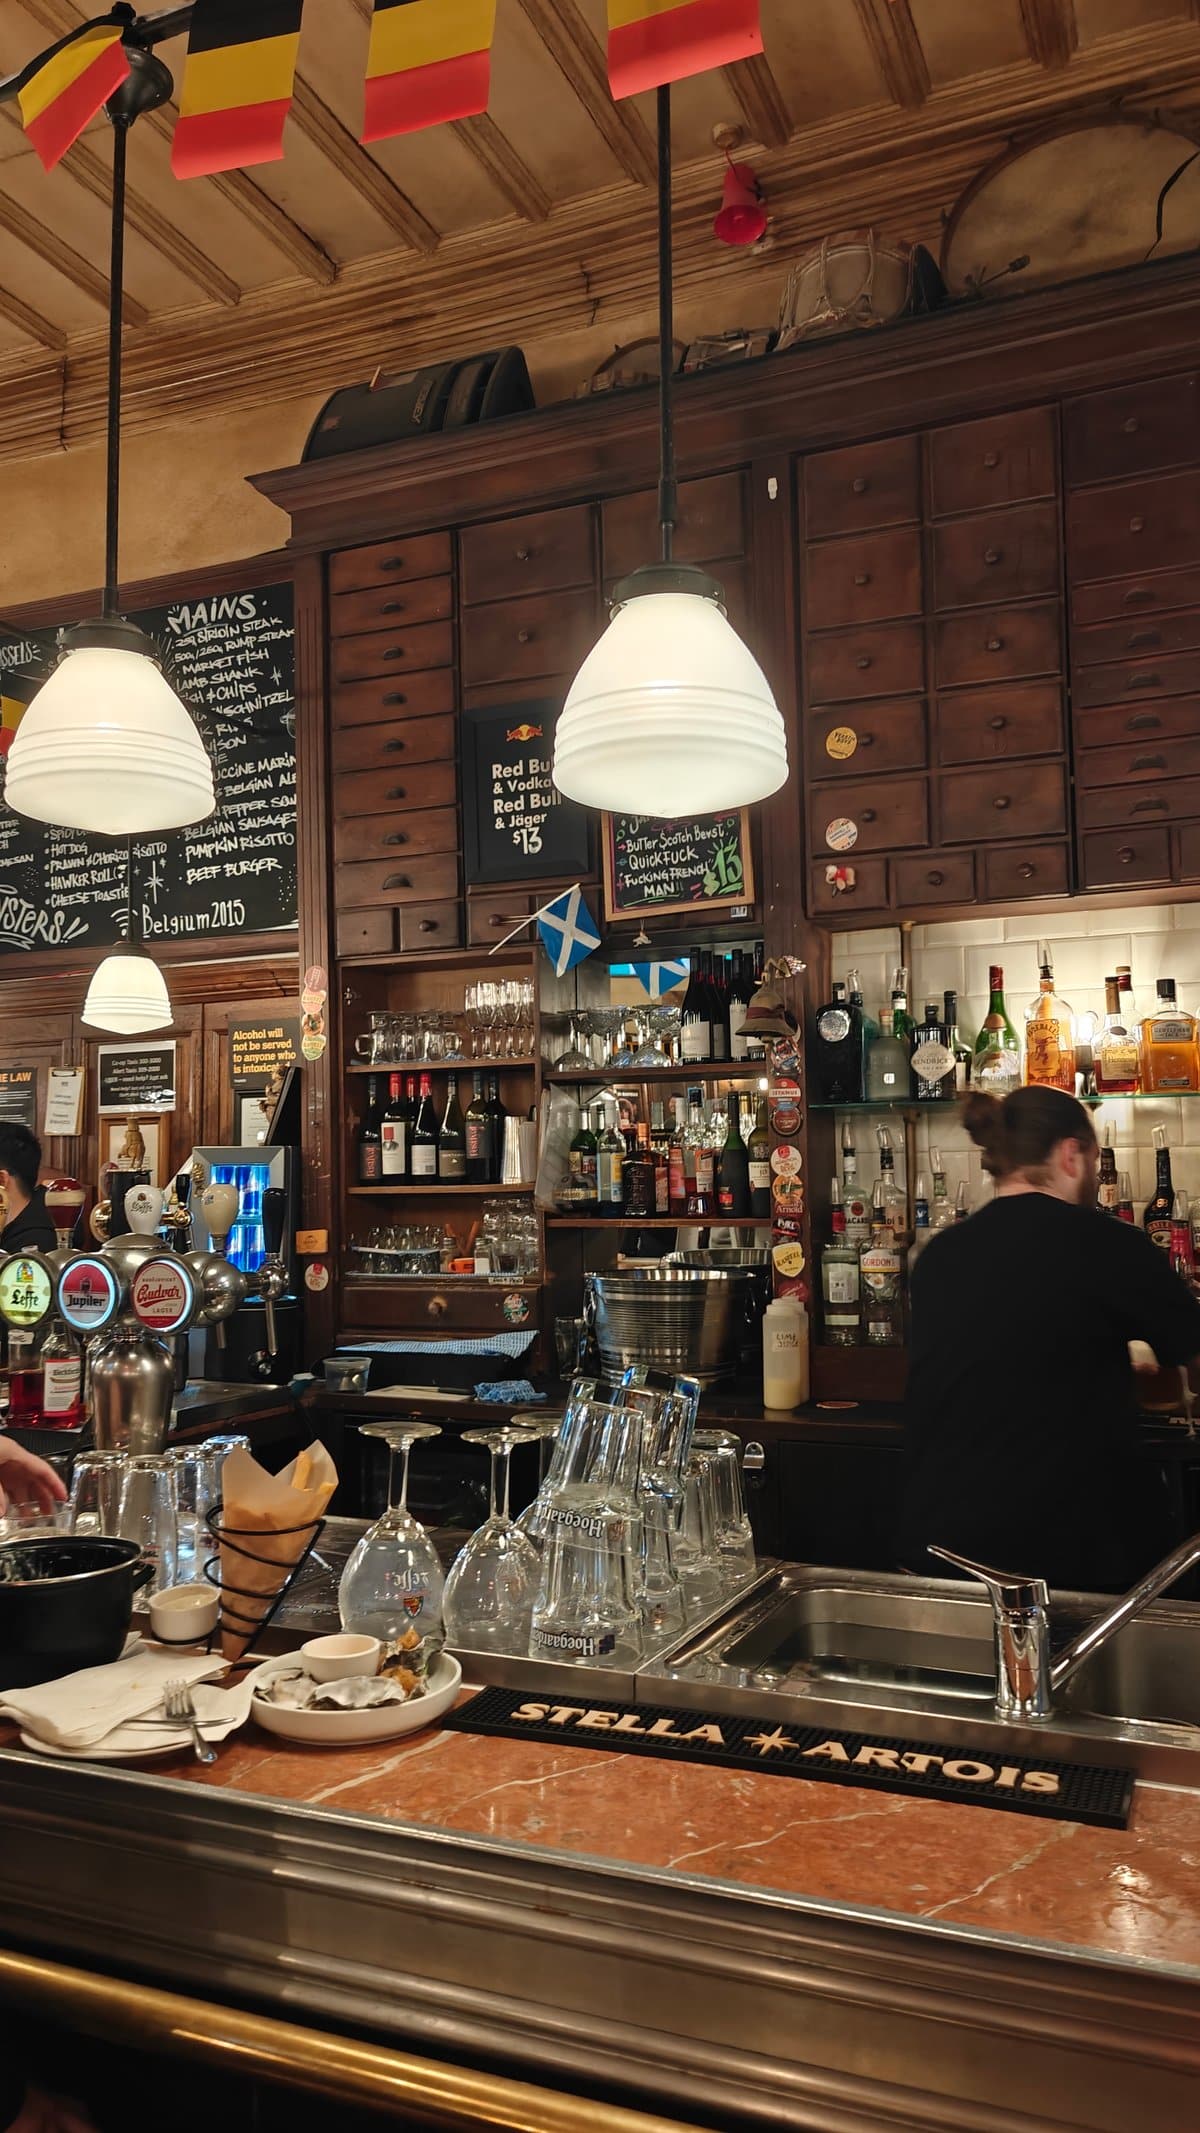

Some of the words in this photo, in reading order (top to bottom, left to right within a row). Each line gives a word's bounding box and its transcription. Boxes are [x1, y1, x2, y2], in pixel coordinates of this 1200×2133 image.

[242, 617, 283, 633] STEAK
[225, 635, 257, 652] RUMP
[257, 629, 296, 643] STEAK
[182, 655, 236, 675] MARKET
[236, 648, 270, 666] FISH
[177, 678, 208, 692] LAMB
[210, 666, 264, 684] SHANK
[216, 679, 258, 701] CHIPS
[491, 760, 524, 780] Red
[528, 758, 555, 775] Bul
[224, 774, 274, 797] BELGIAN
[492, 782, 504, 795] &
[507, 776, 552, 793] Vodka
[493, 795, 525, 815] Red
[530, 790, 562, 810] Bull
[182, 819, 235, 842] BELGIAN
[494, 817, 506, 830] &
[508, 812, 548, 828] Jäger
[184, 835, 239, 864] PUMPKIN
[240, 832, 295, 852] RISOTTO
[512, 826, 543, 855] $13
[186, 865, 222, 886] BEEF
[222, 857, 283, 877] BURGER
[51, 892, 91, 909] CHEESE
[232, 1042, 248, 1052] not
[249, 1041, 261, 1051] be
[262, 1038, 293, 1050] served
[233, 1029, 267, 1041] Alcohol
[267, 1027, 284, 1039] will
[233, 1053, 243, 1063] to
[243, 1052, 277, 1064] anyone
[277, 1050, 297, 1061] who
[233, 1064, 242, 1074] is
[242, 1061, 290, 1073] intoxicat
[10, 1072, 32, 1082] LAW
[11, 1288, 39, 1309] Leffe
[66, 1294, 106, 1308] Jupiler
[510, 1702, 725, 1745] STELLA
[801, 1740, 1061, 1795] ARTOIS
